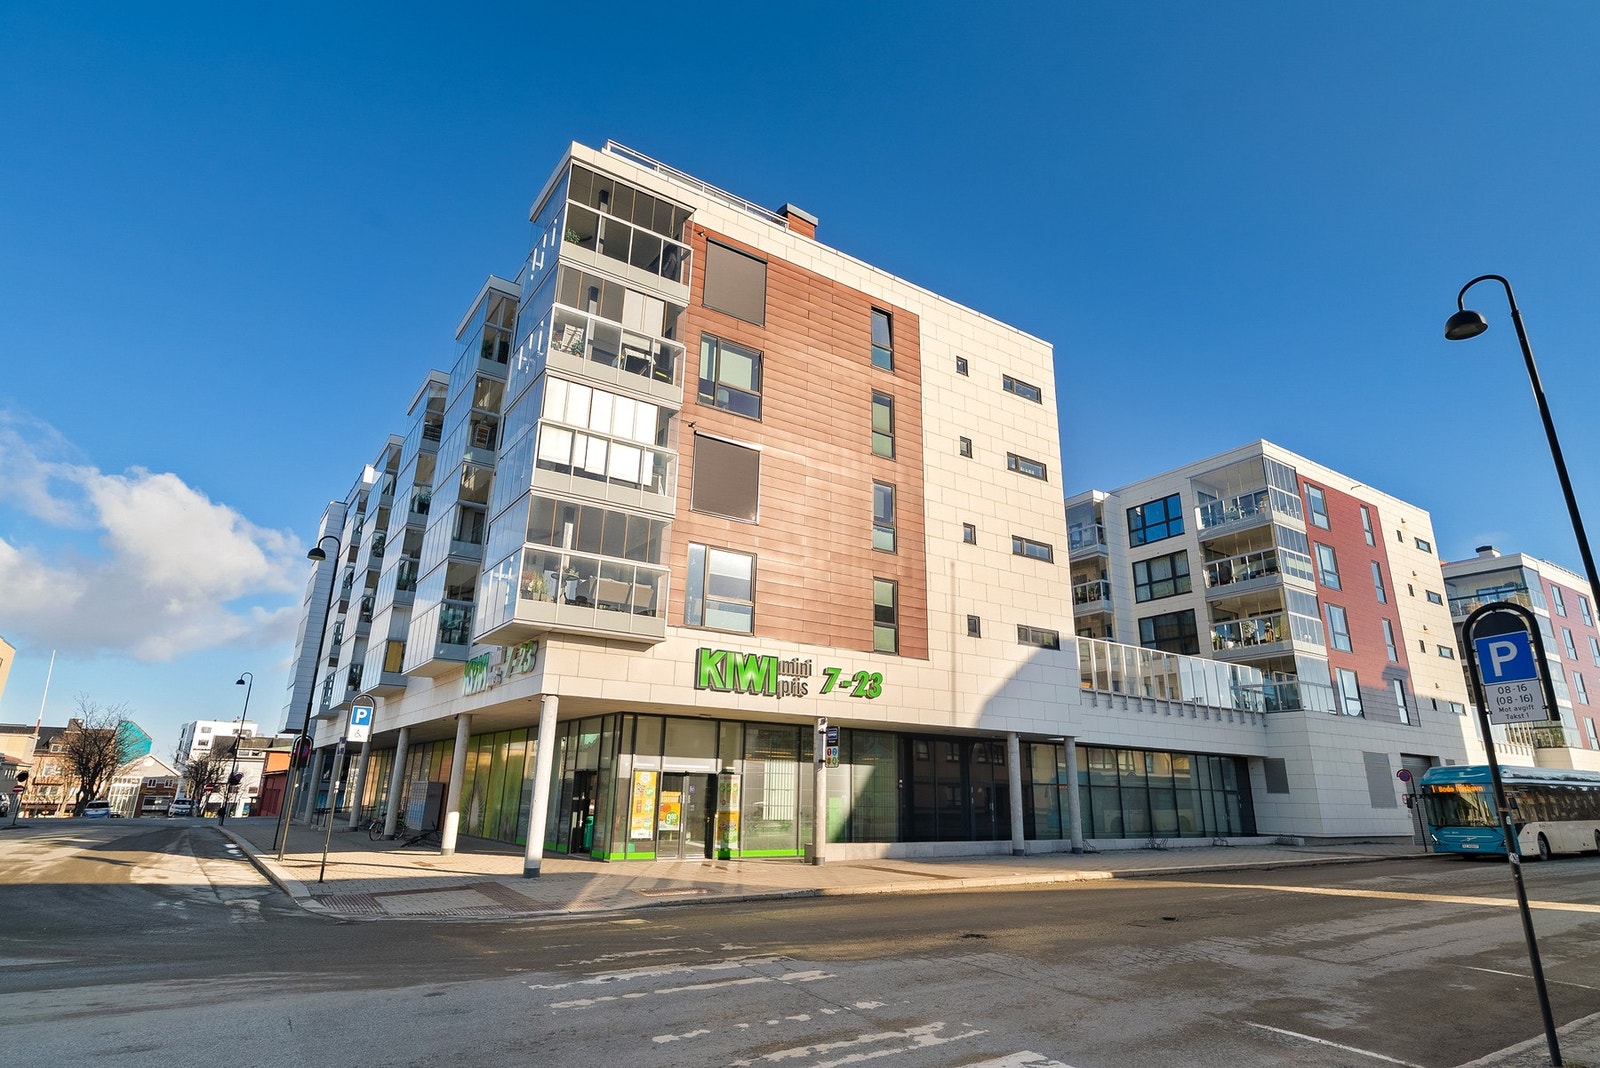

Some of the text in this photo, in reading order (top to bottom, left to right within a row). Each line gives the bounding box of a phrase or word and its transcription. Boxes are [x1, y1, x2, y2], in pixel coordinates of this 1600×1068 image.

[779, 657, 812, 678] mini
[1488, 641, 1518, 676] P
[694, 647, 779, 697] KIWI
[819, 667, 884, 699] 7-23
[777, 677, 809, 699] pris
[355, 708, 368, 724] P
[1513, 704, 1535, 712] avgift
